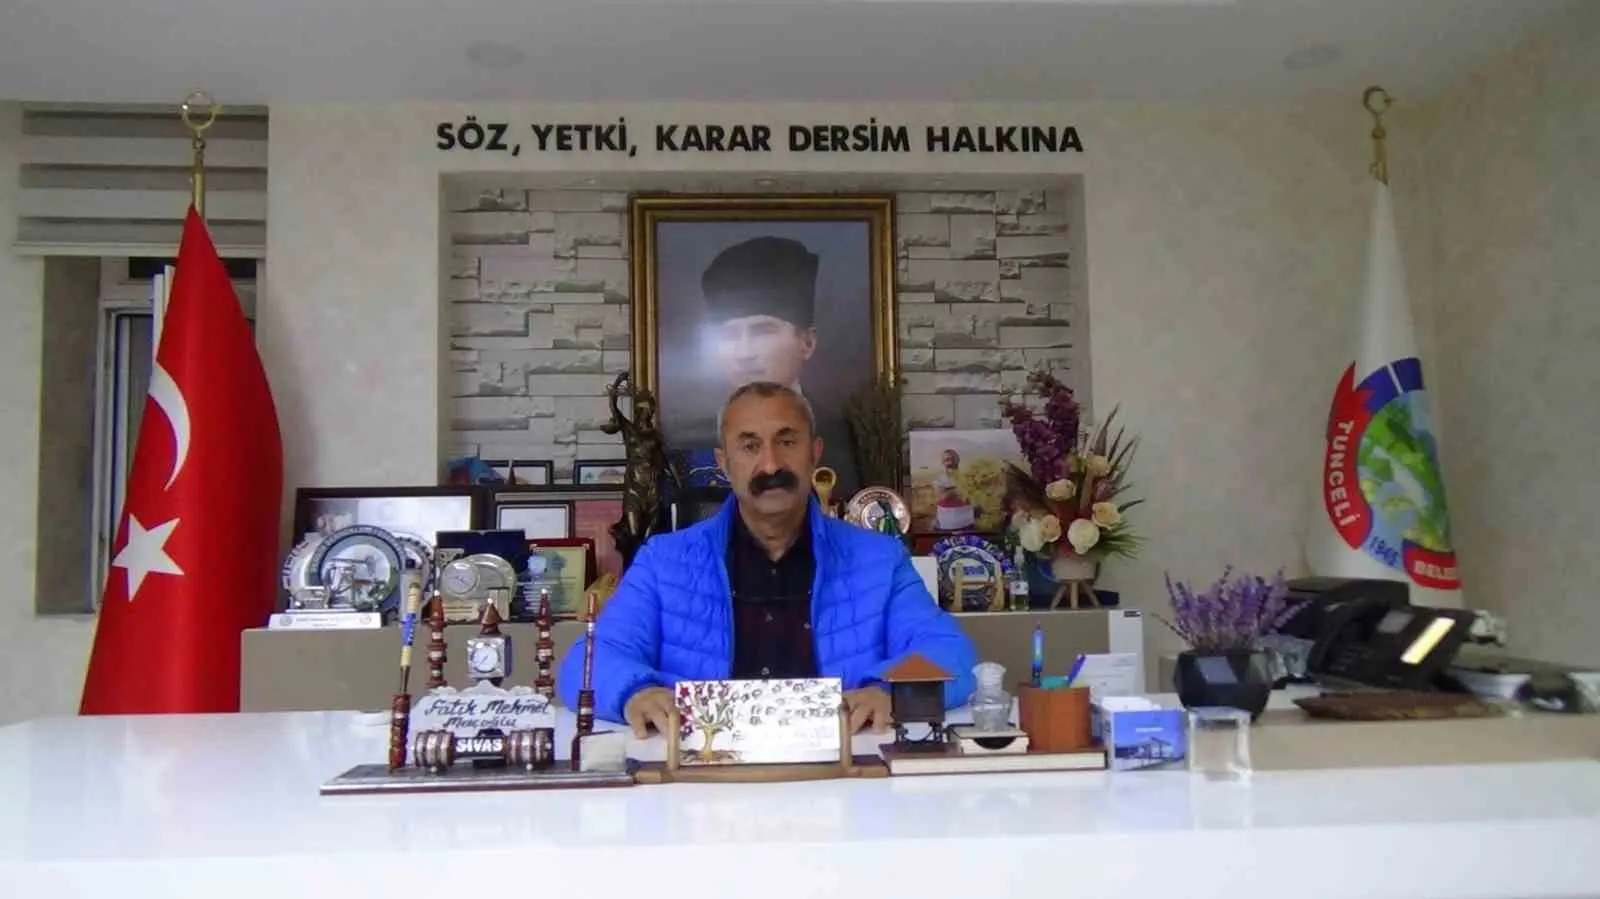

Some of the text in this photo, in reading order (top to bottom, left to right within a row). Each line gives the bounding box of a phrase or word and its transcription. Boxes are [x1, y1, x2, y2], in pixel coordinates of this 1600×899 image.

[437, 116, 1084, 158] SÖZ, YETKİ, KARAR DERSİM HALKINA
[1328, 419, 1361, 527] TUNCELİ
